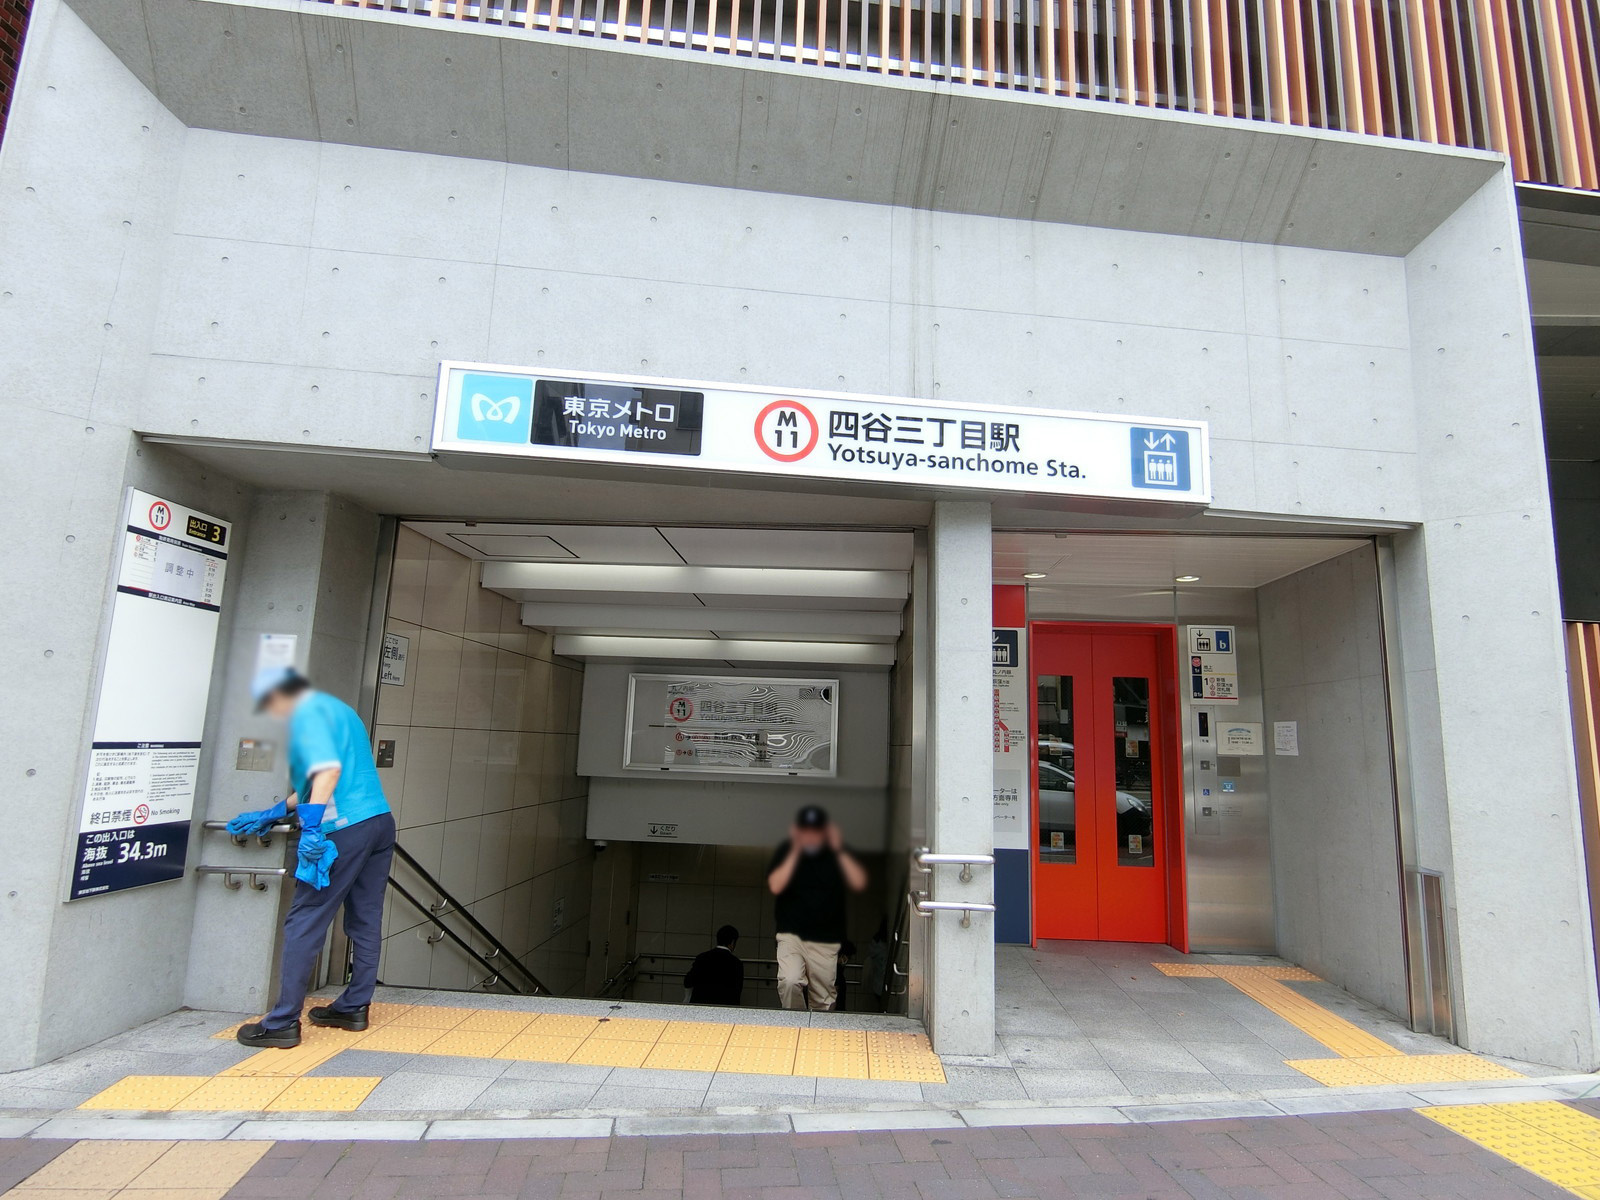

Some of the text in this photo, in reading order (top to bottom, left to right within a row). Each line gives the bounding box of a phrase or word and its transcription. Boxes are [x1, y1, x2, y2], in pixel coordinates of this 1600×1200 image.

[562, 396, 675, 423] 東京メトロ
[777, 411, 798, 428] M
[569, 420, 667, 441] Tokyo Metro
[828, 410, 1020, 453] 四谷三丁目駅
[774, 430, 798, 449] 11
[828, 443, 1086, 479] Yotsuya-sanchome Sta.
[157, 506, 164, 515] M
[156, 515, 164, 524] 11
[190, 519, 207, 532] 出入口
[212, 526, 221, 542] 3
[165, 562, 194, 579] 調整中
[1219, 639, 1226, 649] b
[676, 709, 686, 717] 11
[677, 701, 686, 709] M
[90, 809, 132, 825] 終日禁煙
[159, 807, 180, 816] Smoking
[86, 829, 135, 844] この出入口は
[83, 841, 167, 864] 海抜 34.3m
